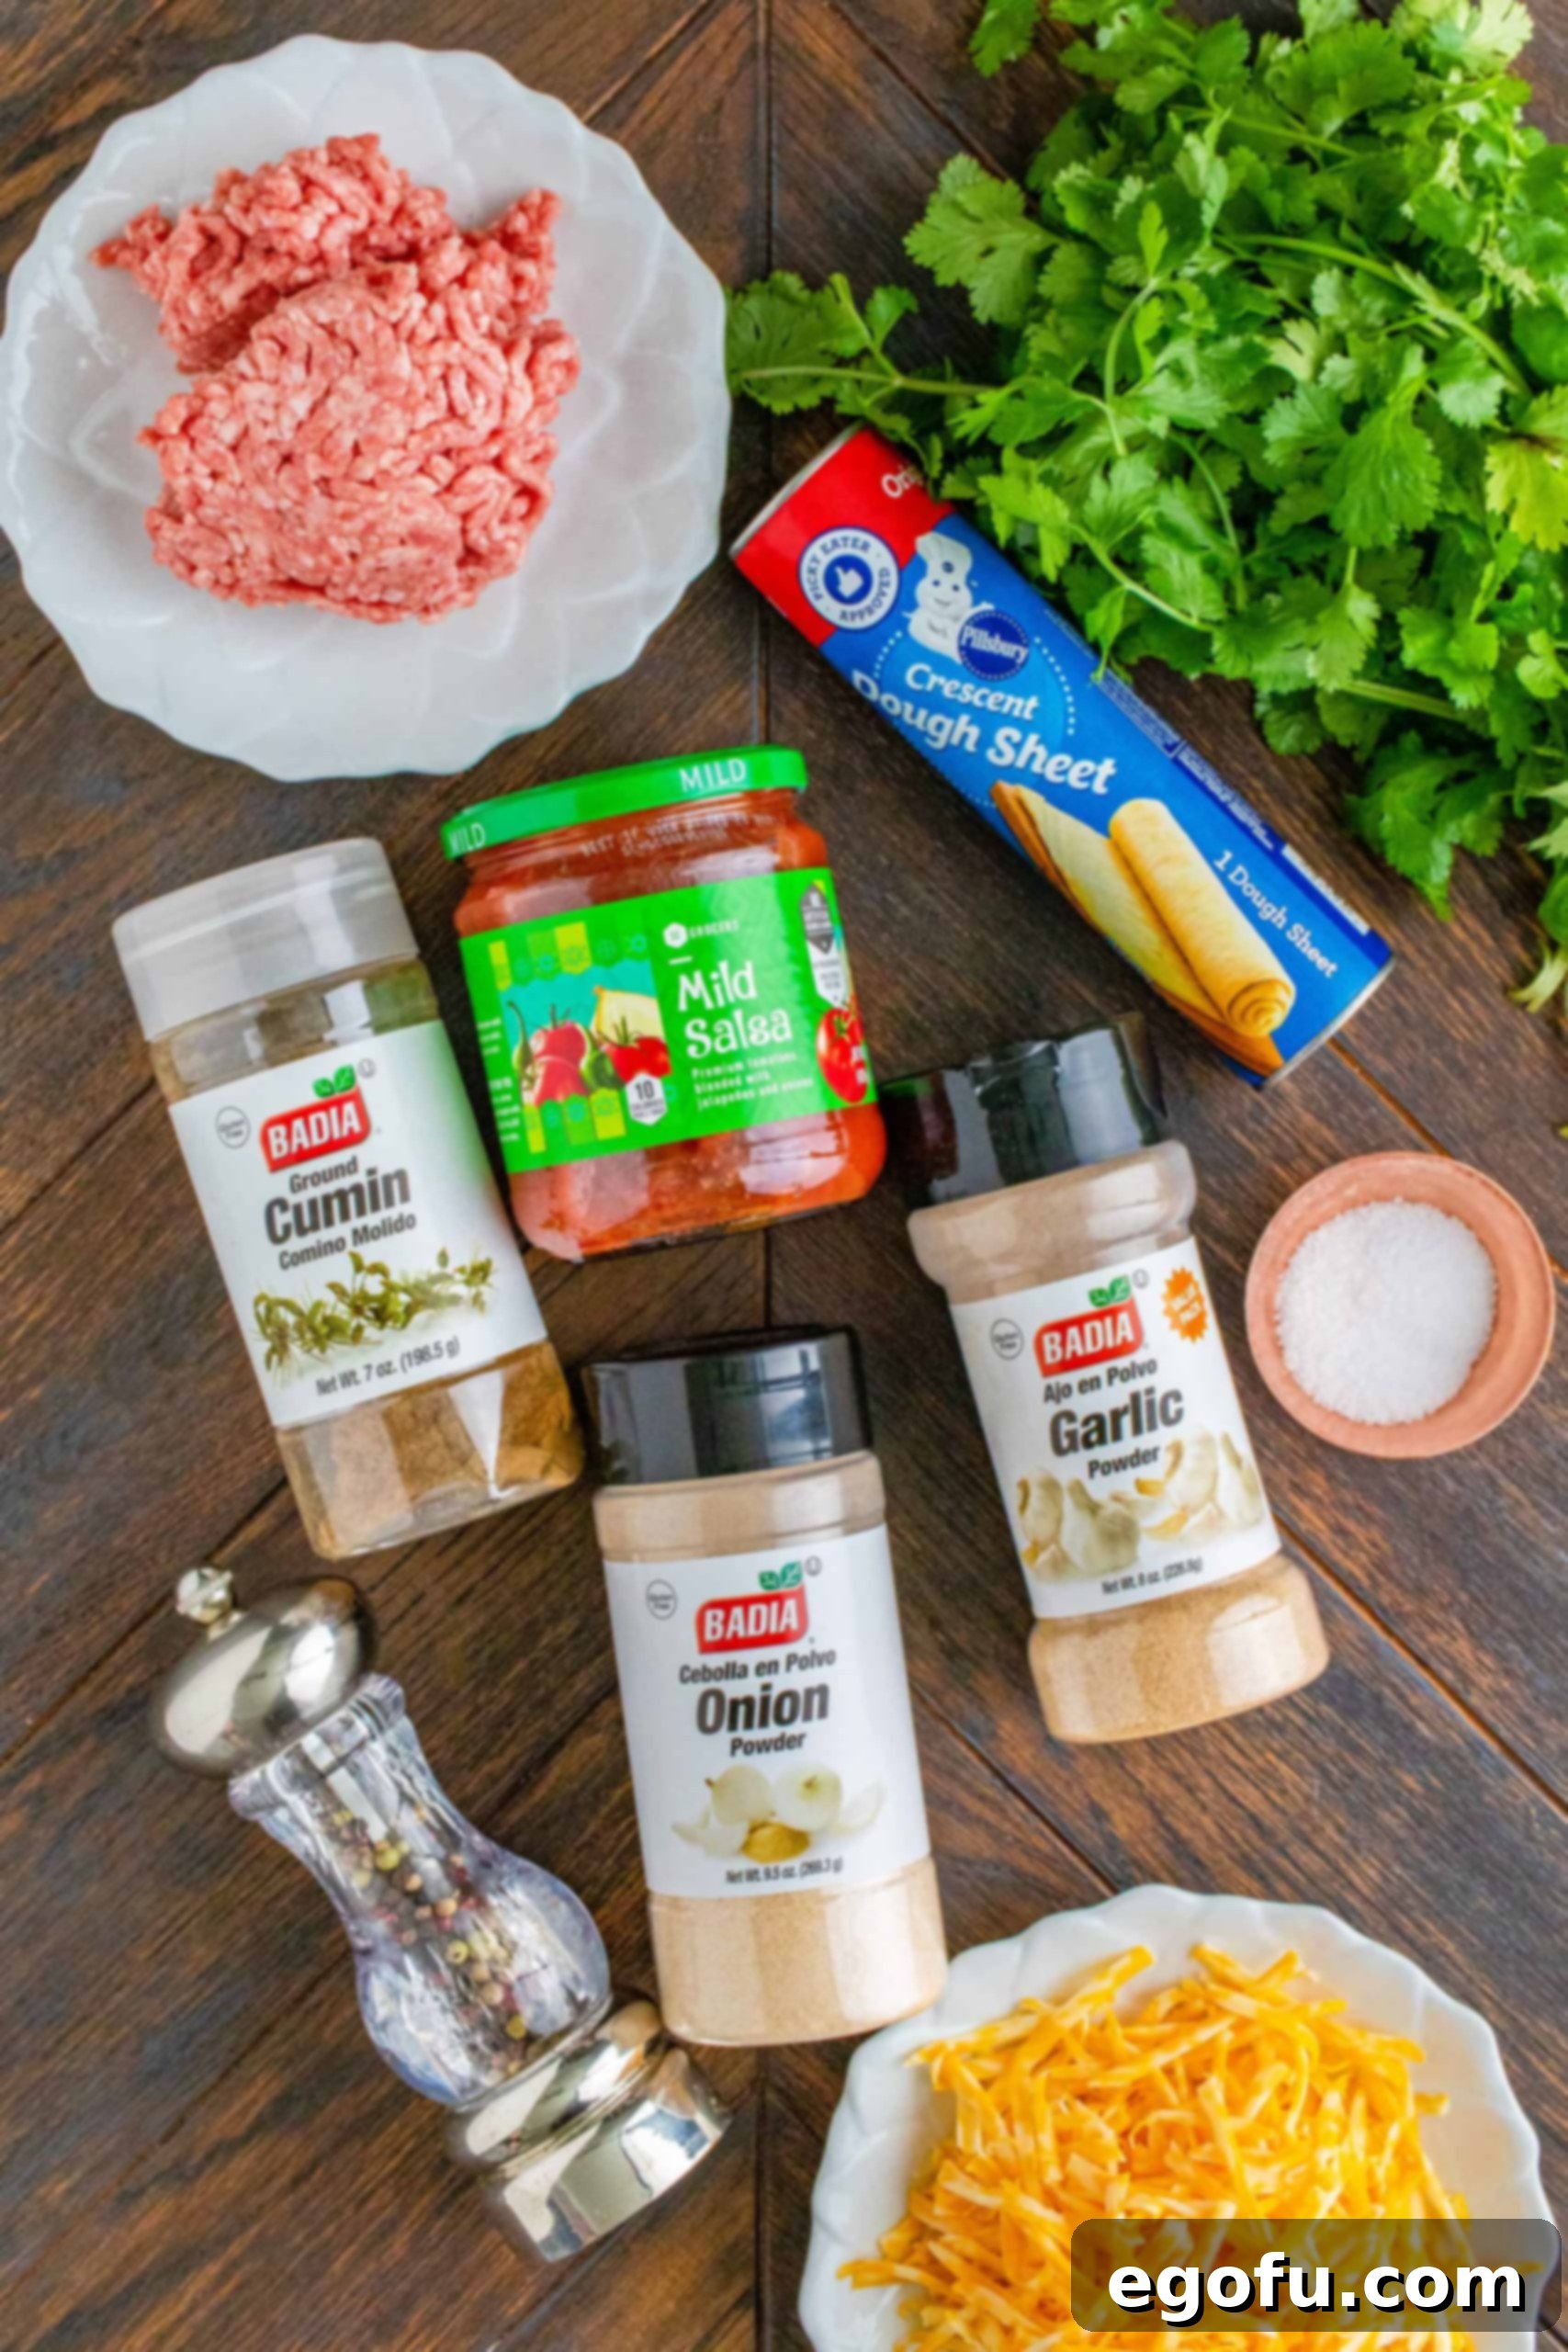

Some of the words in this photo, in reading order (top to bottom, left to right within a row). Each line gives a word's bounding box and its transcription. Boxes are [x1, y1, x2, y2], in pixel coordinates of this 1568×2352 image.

[807, 553, 824, 602] PICKY
[819, 536, 872, 555] EATER
[839, 566, 891, 623] APPROVED
[963, 625, 1030, 665] Pillsbury
[905, 662, 1040, 720] Crescent
[852, 669, 980, 752] Dough
[987, 727, 1117, 795] Sheet
[678, 758, 747, 793] MILD
[1213, 849, 1234, 872] 1
[1227, 865, 1289, 930] Dough
[1286, 922, 1338, 978] Sheet
[677, 960, 758, 1012] Mild
[685, 1007, 793, 1060] Salsa
[636, 1080, 655, 1101] 10
[692, 1061, 744, 1080] Premium
[694, 1075, 742, 1094] blended
[267, 1102, 362, 1159] BADIA
[289, 1156, 359, 1193] Ground
[264, 1166, 412, 1246] Cumin
[278, 1238, 346, 1271] Comino
[351, 1212, 417, 1248] Molido
[1042, 1311, 1135, 1366] BADIA
[316, 1375, 337, 1396] Net
[364, 1363, 373, 1381] 7
[376, 1361, 397, 1378] oz.
[1043, 1384, 1072, 1406] Ajo
[1077, 1379, 1101, 1396] en
[1107, 1358, 1157, 1387] Polvo
[1049, 1386, 1184, 1458] Garlic
[1088, 1445, 1160, 1479] Powder
[704, 1599, 799, 1643] BADIA
[679, 1661, 749, 1685] Cebolla
[754, 1661, 779, 1677] en
[785, 1648, 837, 1674] Polvo
[696, 1682, 830, 1736] Onion
[729, 1731, 807, 1758] Powder
